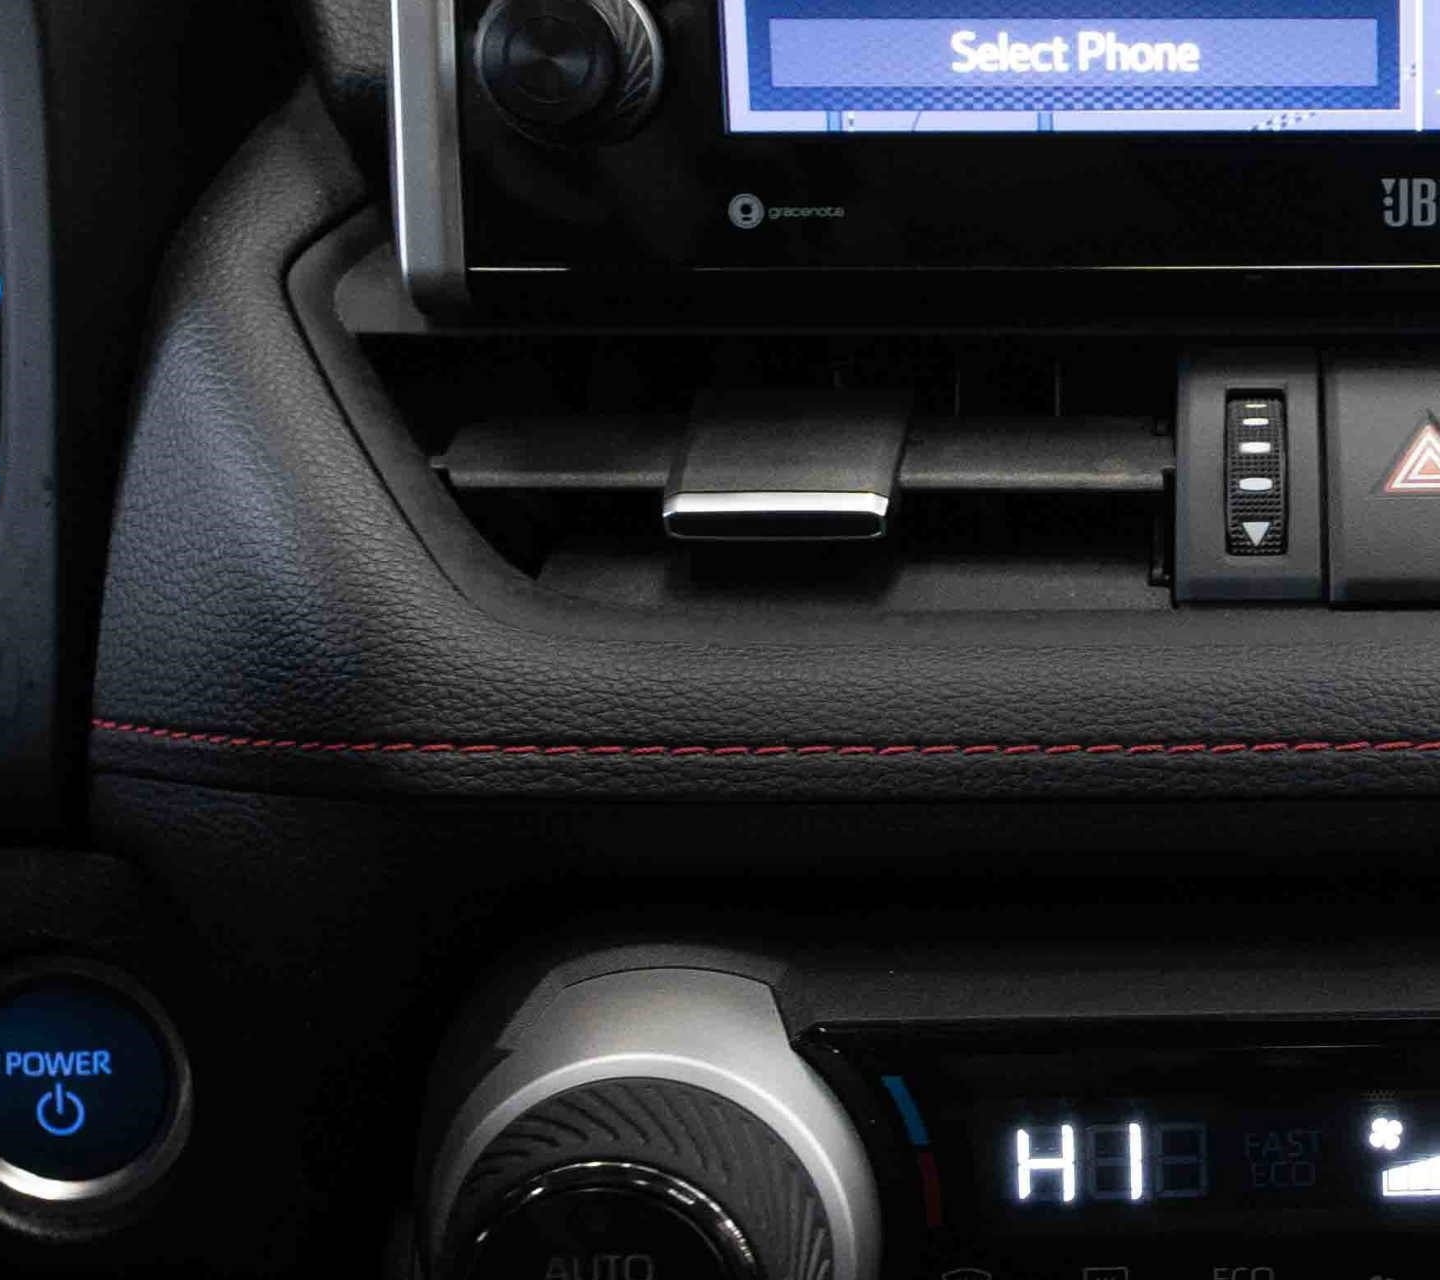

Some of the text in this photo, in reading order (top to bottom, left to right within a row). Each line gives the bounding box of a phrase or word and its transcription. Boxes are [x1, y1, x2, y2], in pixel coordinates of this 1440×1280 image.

[949, 30, 1201, 73] Select Phone
[5, 1049, 112, 1077] POWER
[1013, 1122, 1147, 1203] HI
